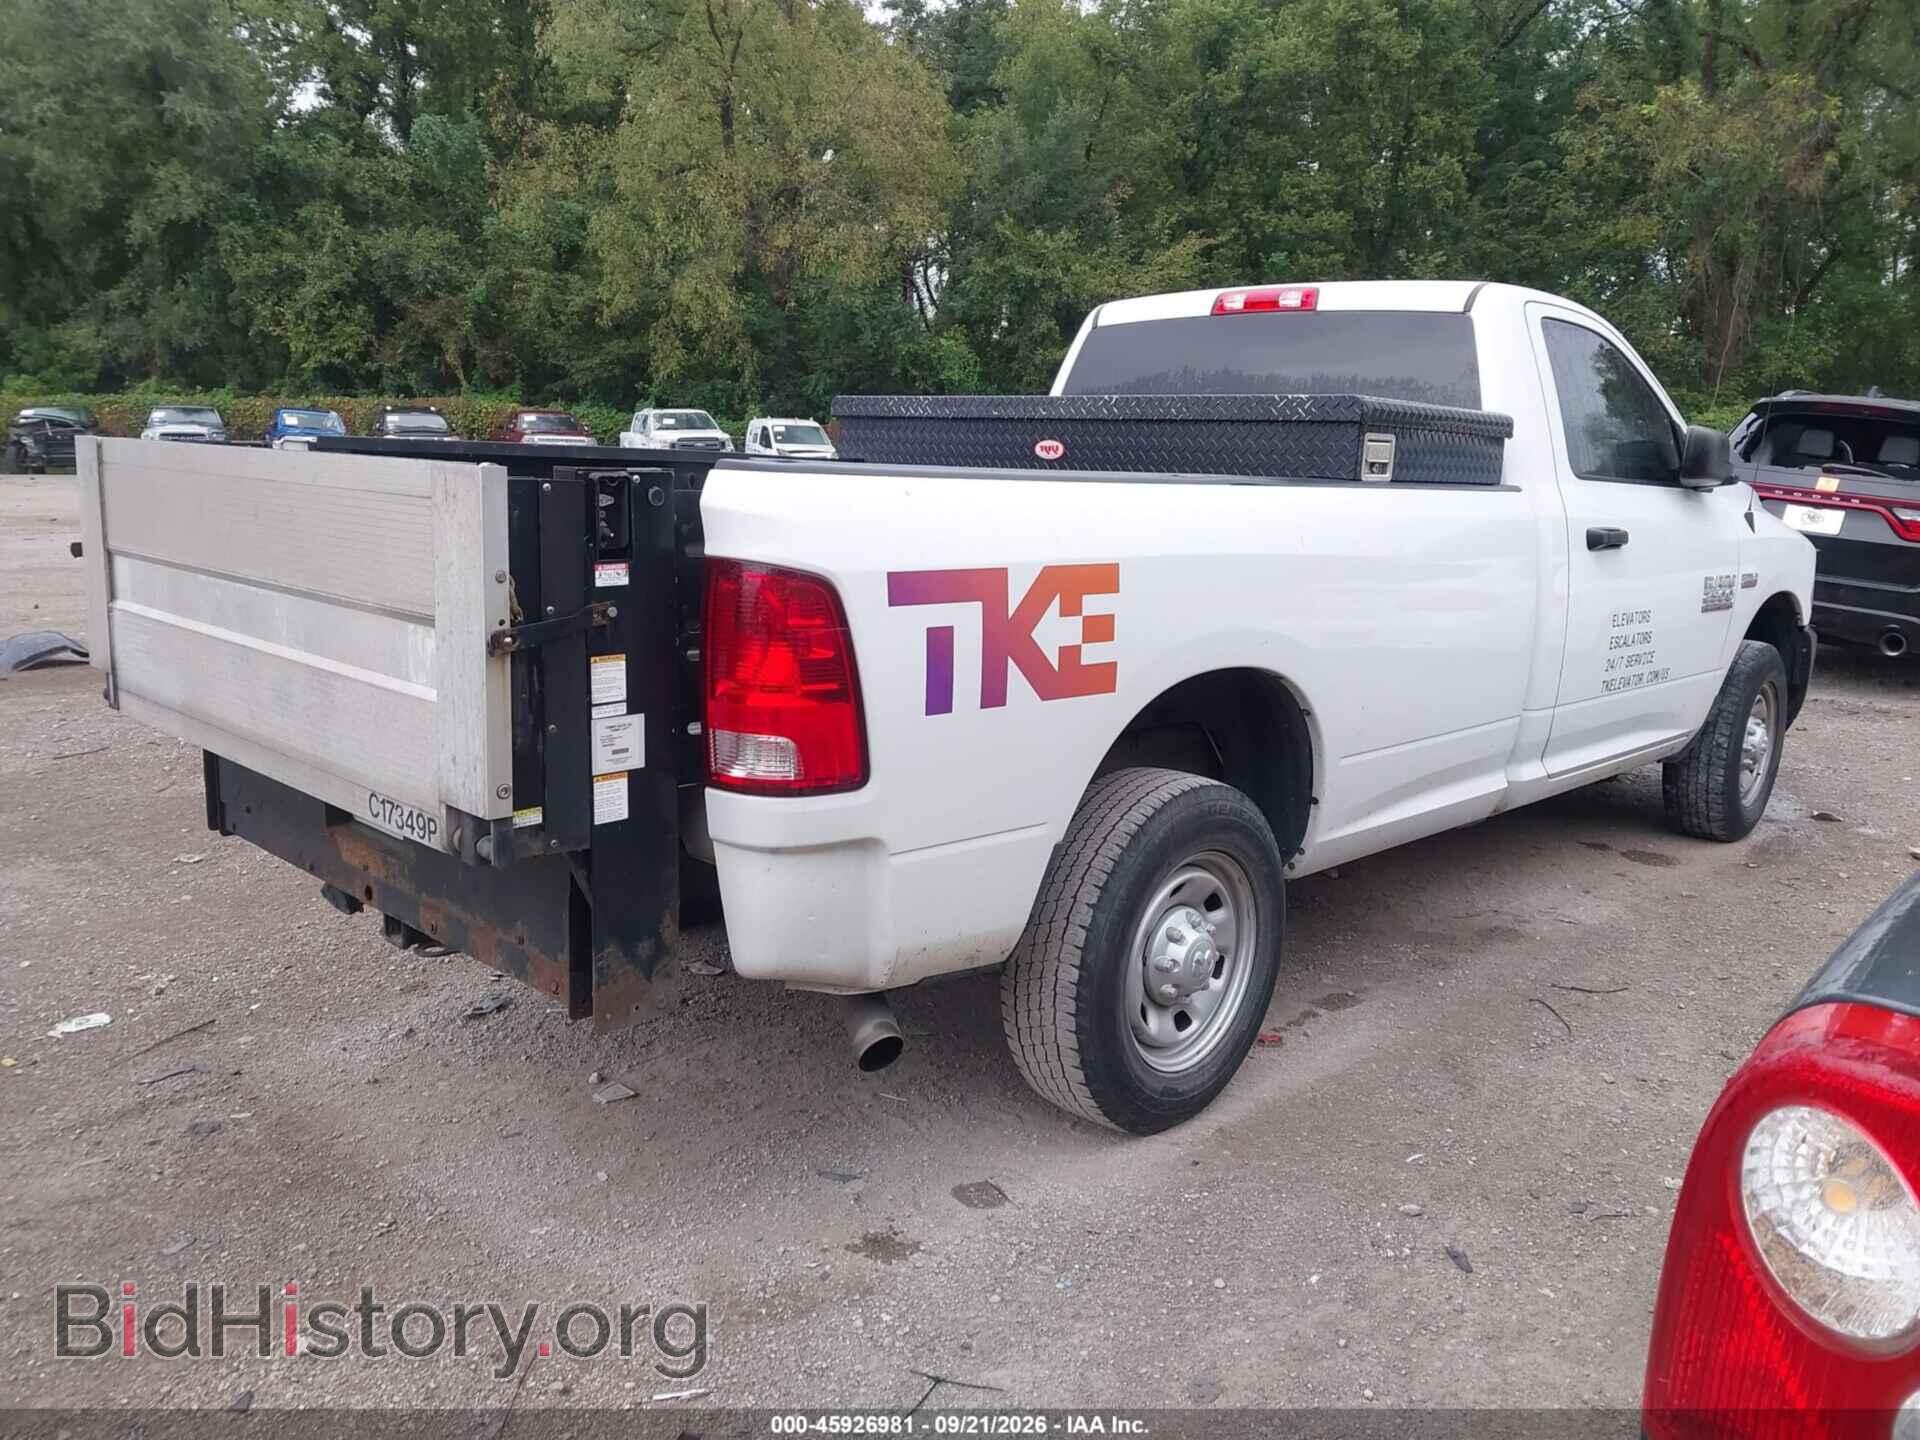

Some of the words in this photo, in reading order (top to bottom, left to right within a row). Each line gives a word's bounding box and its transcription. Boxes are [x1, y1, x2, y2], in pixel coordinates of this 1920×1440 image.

[1612, 610, 1651, 628] ELEVATORS
[887, 563, 1120, 716] TKE
[1609, 631, 1652, 650] ESCALATORS
[1604, 656, 1624, 672] 24/7
[1625, 650, 1655, 668] SERVICE
[368, 792, 437, 842] C17349P
